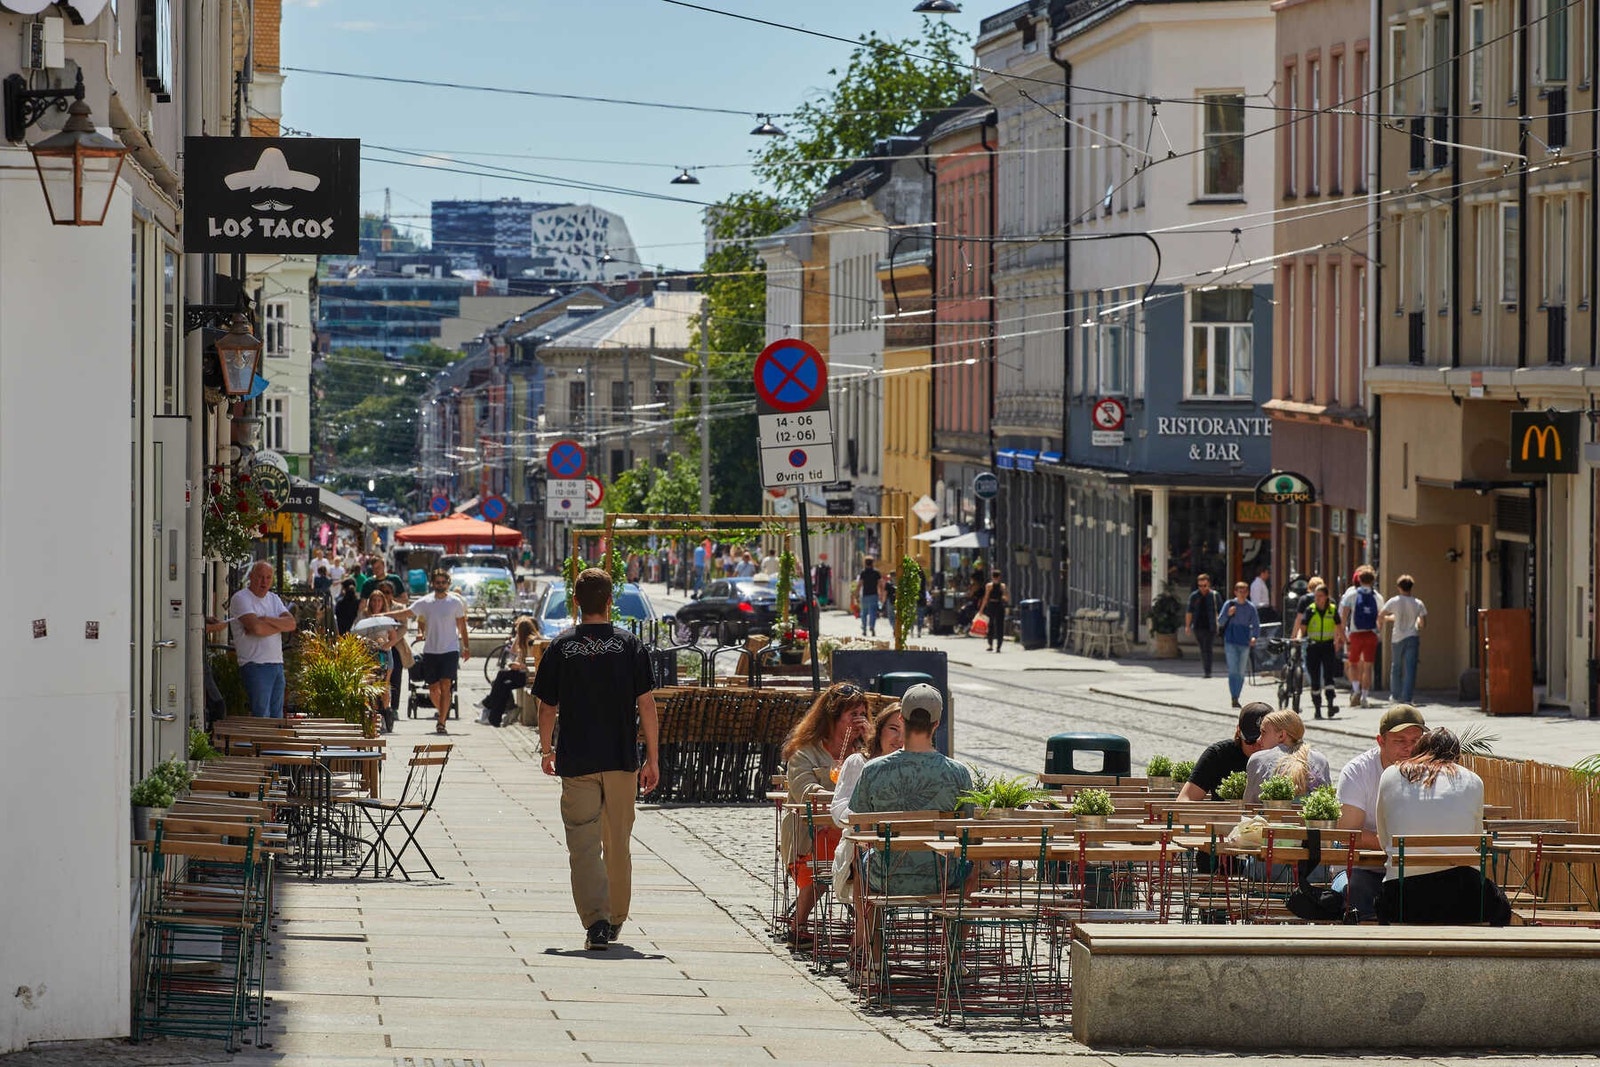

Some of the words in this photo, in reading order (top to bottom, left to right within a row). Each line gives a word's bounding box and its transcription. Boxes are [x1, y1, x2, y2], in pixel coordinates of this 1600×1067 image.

[208, 216, 253, 238] LOS
[259, 217, 334, 239] TACOS
[1158, 417, 1272, 436] RISTORANTE
[1189, 443, 1201, 460] &
[1205, 442, 1241, 460] BAR
[776, 471, 805, 482] Øvrig
[809, 469, 823, 480] tid
[305, 496, 313, 505] G
